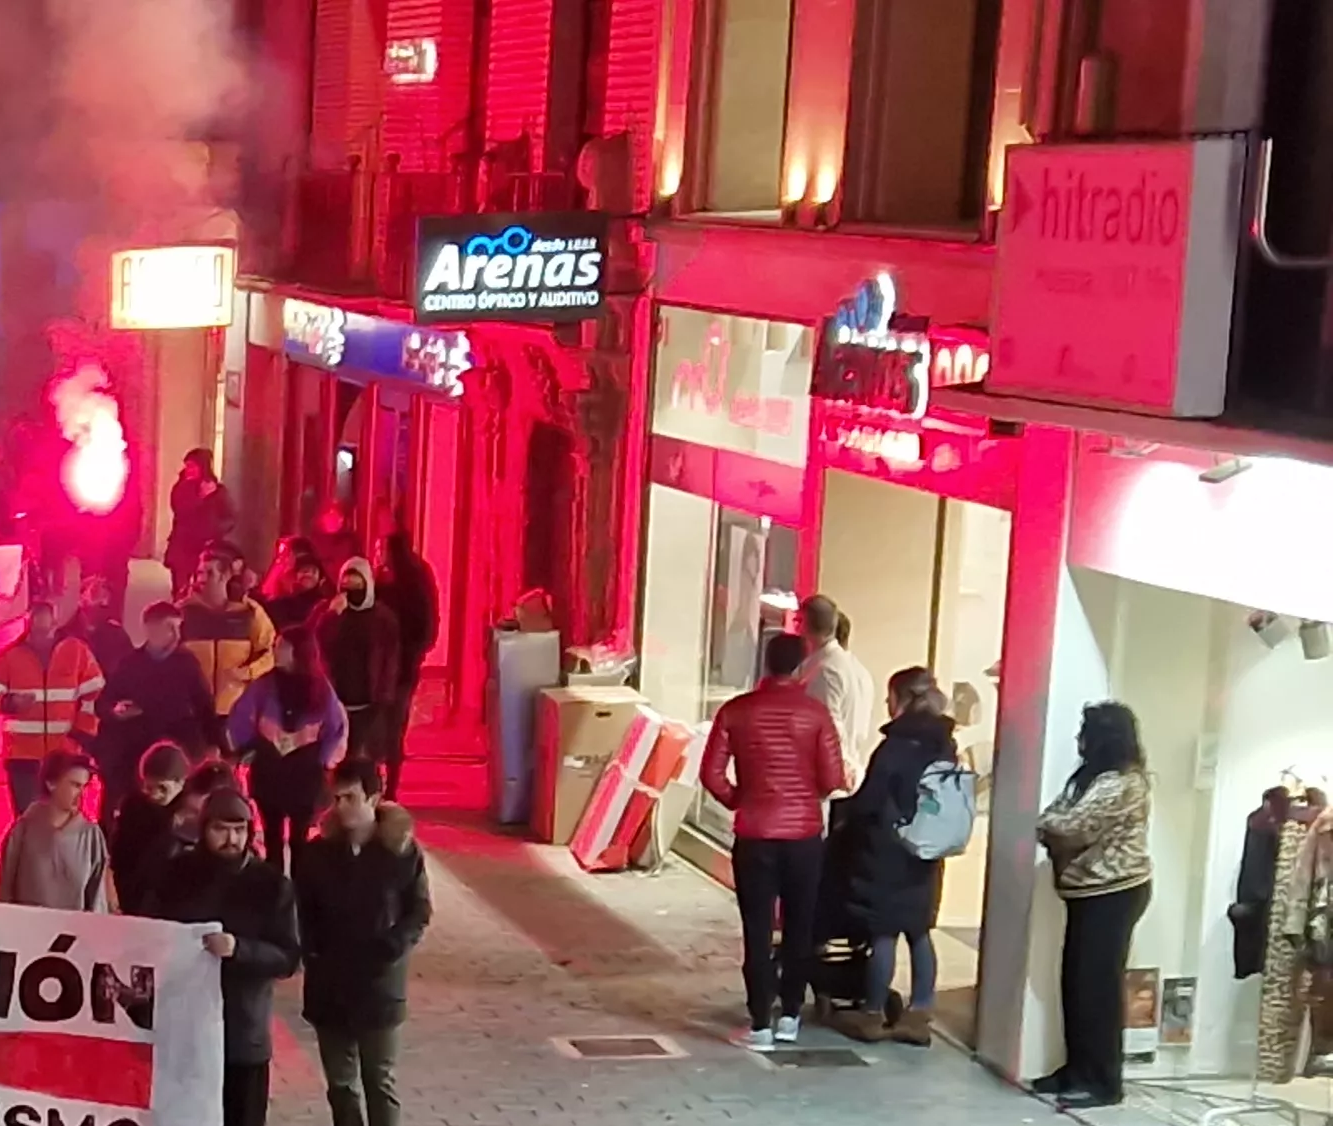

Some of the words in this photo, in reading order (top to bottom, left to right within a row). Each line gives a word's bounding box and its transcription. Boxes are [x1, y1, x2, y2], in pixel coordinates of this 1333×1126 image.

[1041, 167, 1180, 247] hitradio
[424, 243, 602, 291] Arenas
[528, 292, 538, 308] Y
[538, 290, 600, 308] AUDITIVO
